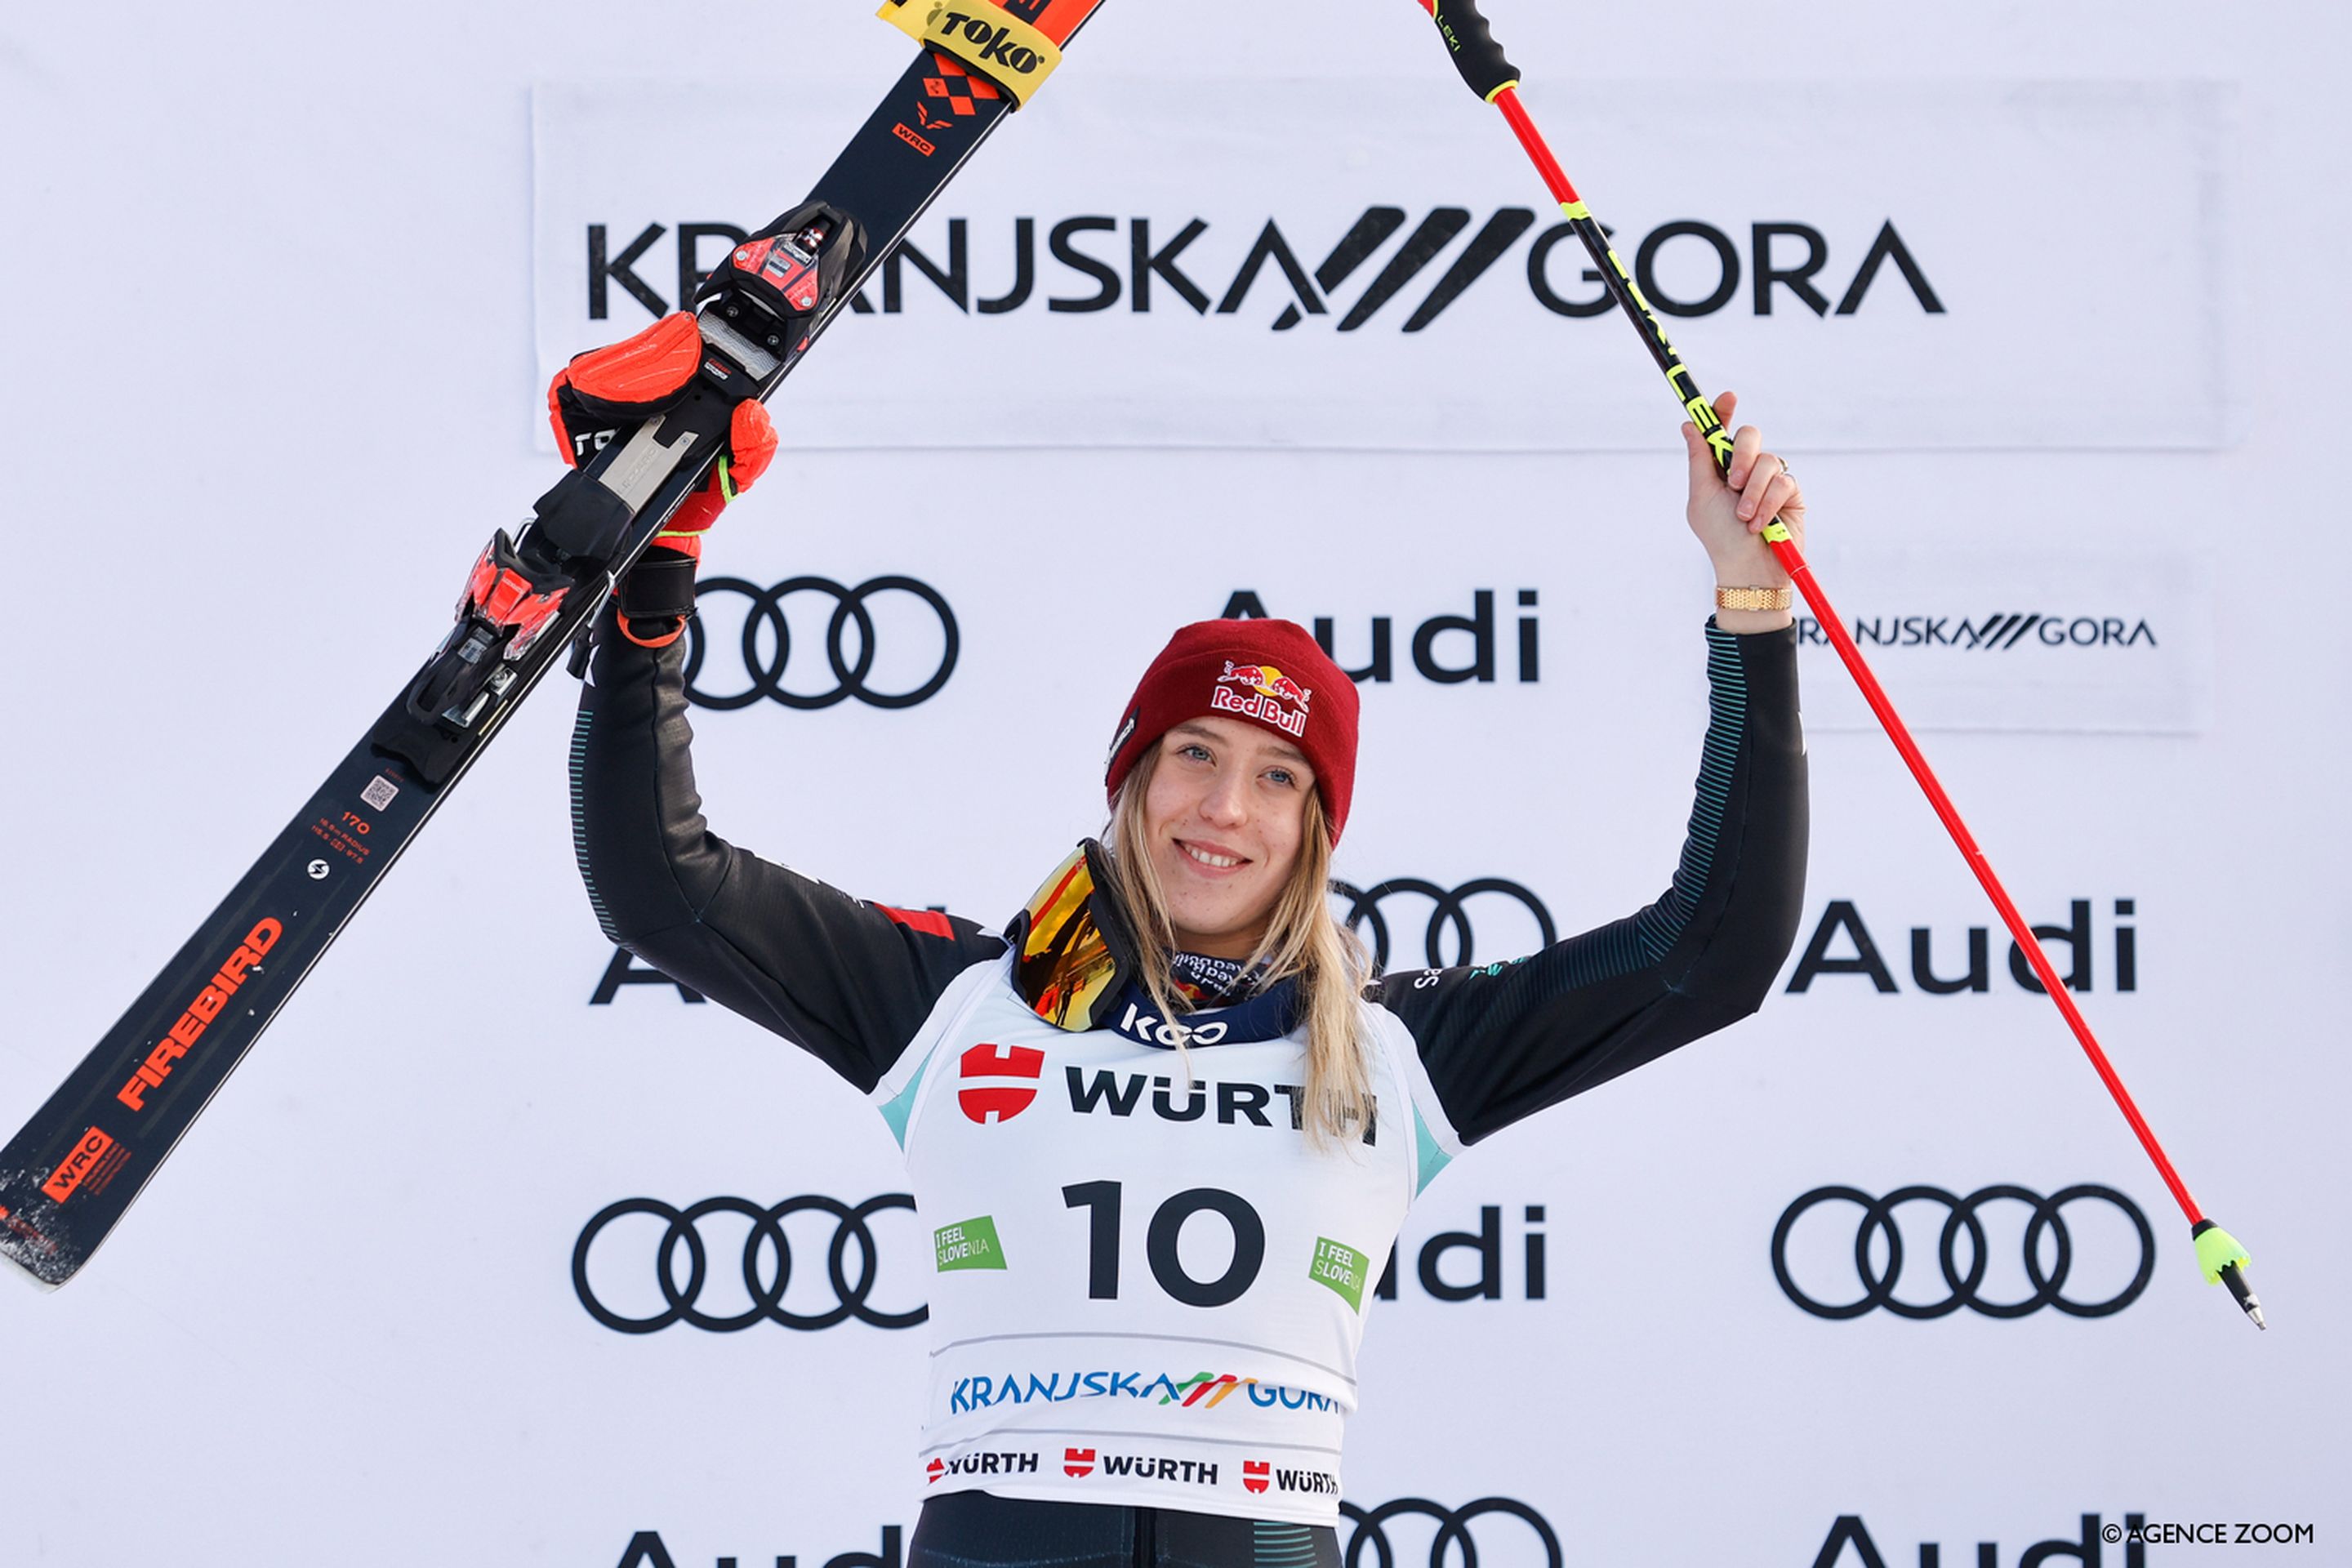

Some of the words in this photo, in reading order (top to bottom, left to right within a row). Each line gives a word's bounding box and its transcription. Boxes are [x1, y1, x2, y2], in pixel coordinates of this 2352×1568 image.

[941, 12, 1038, 74] TOKO
[1435, 15, 1462, 52] LEKI
[898, 126, 932, 153] WRC
[587, 217, 1328, 319] KRNJSKA
[1527, 218, 1948, 318] GORA
[1665, 363, 1735, 475] LEK
[1798, 616, 1980, 648] RNJSKA
[2038, 617, 2157, 647] GORA
[1211, 685, 1263, 718] Red
[1260, 697, 1307, 737] Bull
[341, 811, 370, 835] 170
[341, 833, 370, 856] RADIUS
[1784, 898, 2136, 994] Audi
[117, 917, 283, 1111] FIREBIRD
[51, 1133, 105, 1190] WRC
[936, 1233, 941, 1250] I
[941, 1226, 966, 1247] FEEL
[938, 1237, 991, 1267] SLOVENIA
[1062, 1179, 1266, 1308] 10
[1318, 1241, 1327, 1258] I
[1327, 1244, 1354, 1268] FEEL
[951, 1371, 1181, 1415] KRANJSKA
[1103, 1455, 1218, 1485] WÜRTH
[1276, 1468, 1339, 1495] WÜRTH
